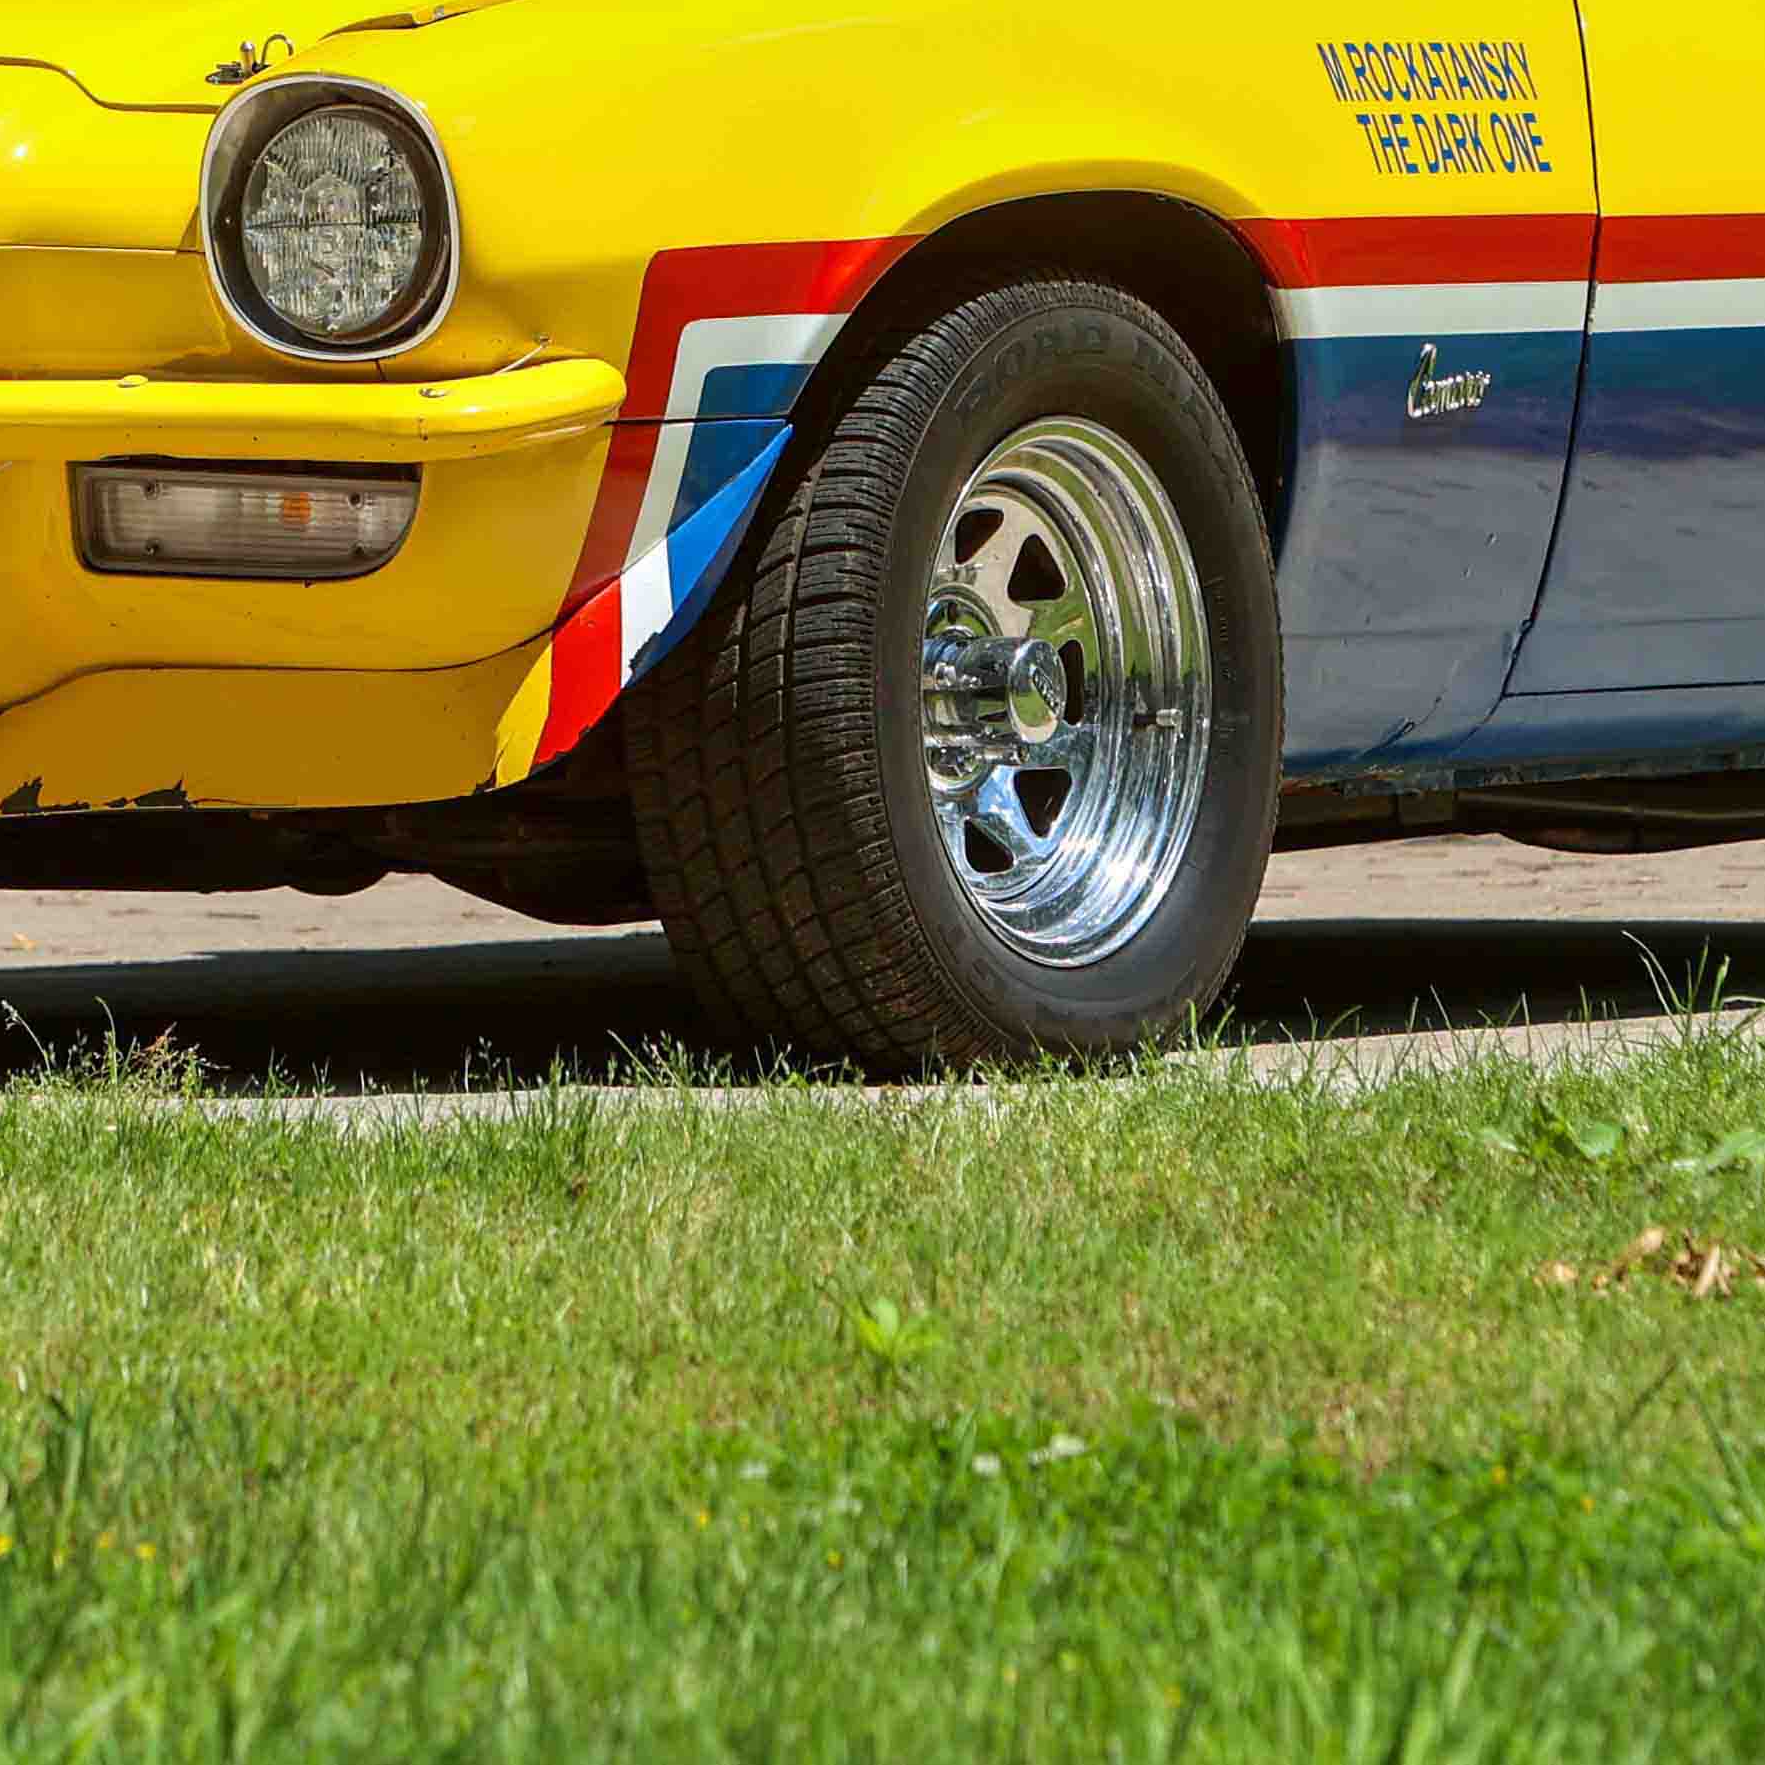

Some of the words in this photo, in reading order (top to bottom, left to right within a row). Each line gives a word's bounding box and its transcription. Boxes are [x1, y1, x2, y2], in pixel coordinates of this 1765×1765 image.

[1356, 112, 1420, 174] THE
[1411, 112, 1496, 174] DARK
[1489, 112, 1553, 174] ONE
